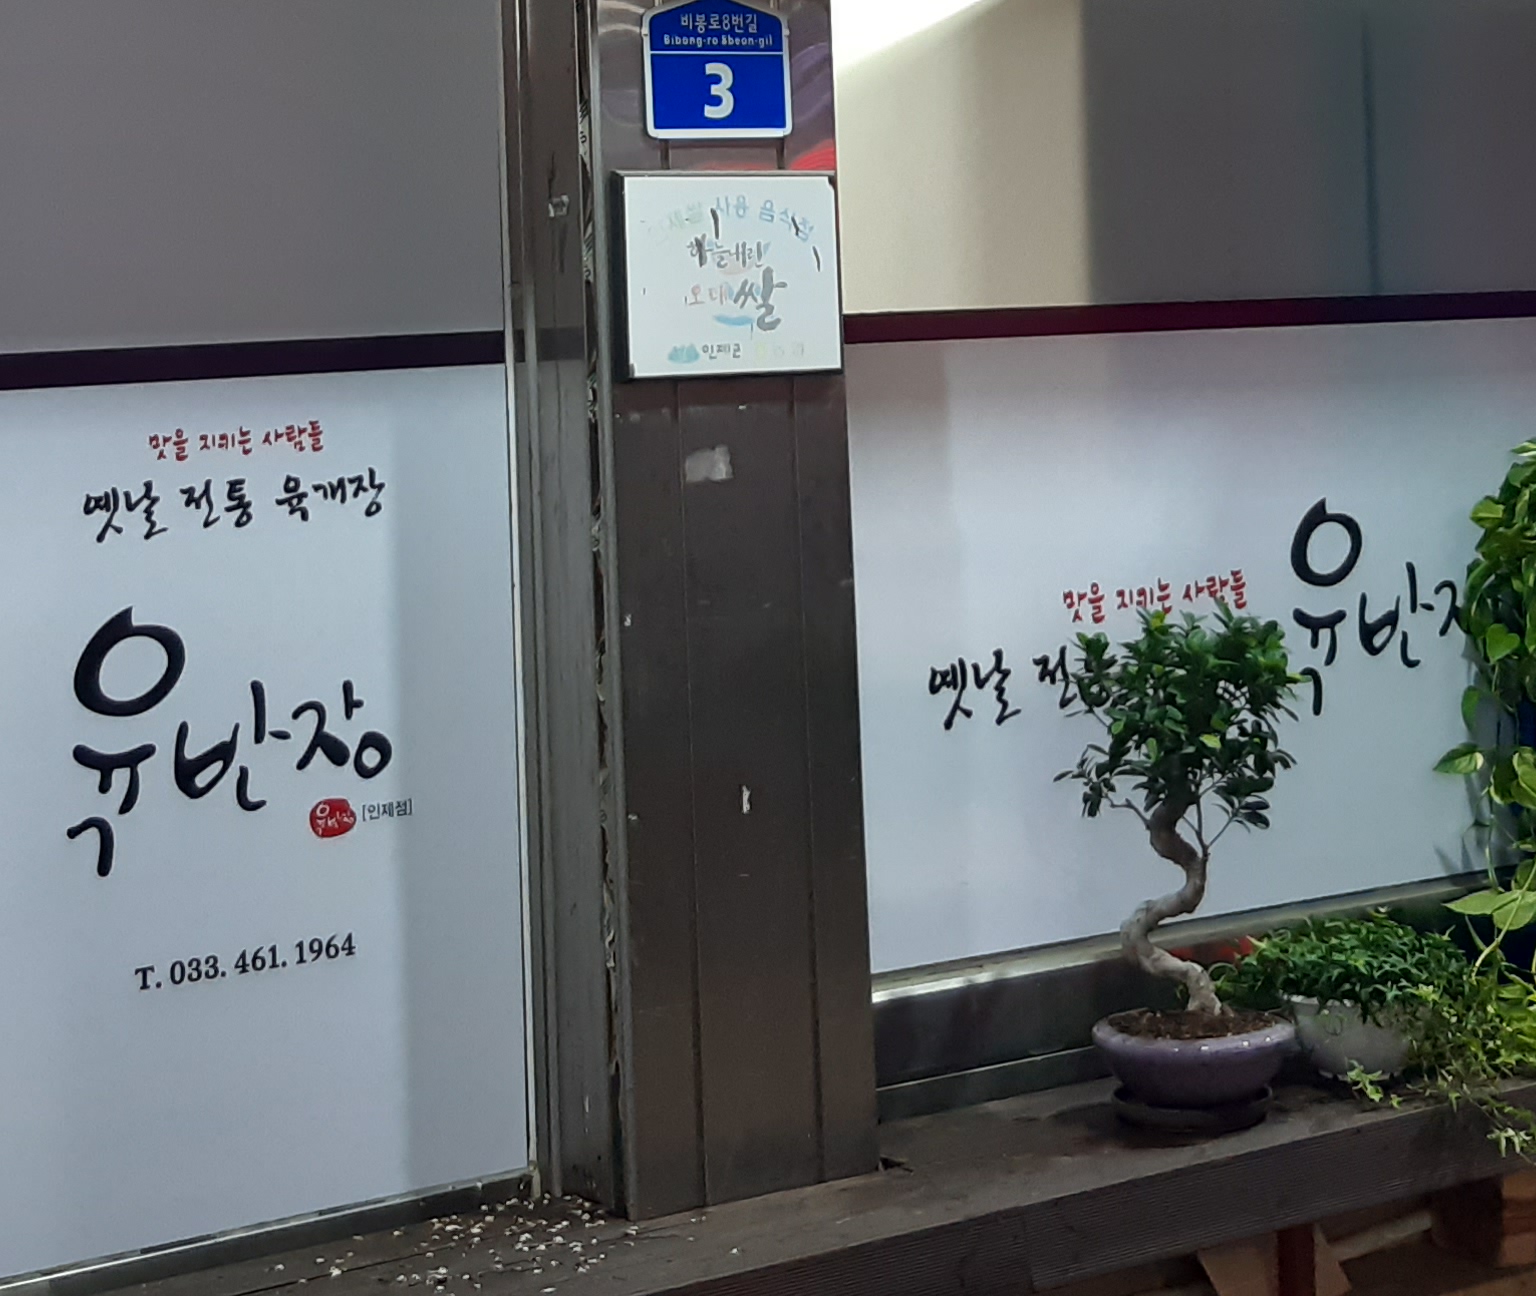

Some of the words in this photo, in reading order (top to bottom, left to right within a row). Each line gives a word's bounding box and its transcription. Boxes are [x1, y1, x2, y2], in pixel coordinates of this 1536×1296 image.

[664, 34, 718, 48] Bibong-ro
[721, 34, 773, 49] 8beon-gil
[680, 14, 758, 34] 비봉로8번길
[704, 62, 735, 119] 3
[149, 430, 188, 463] 맛을
[200, 429, 251, 456] 지키는
[263, 421, 322, 453] 사람들
[82, 479, 168, 544] 옛날
[179, 478, 253, 529] 전통
[275, 467, 386, 522] 육개장
[1064, 584, 1106, 624] 맛을
[1116, 578, 1173, 615] 지키는
[1184, 570, 1247, 610] 사람들
[928, 648, 1022, 731] 옛날
[1032, 645, 1077, 710] 전
[66, 606, 394, 878] 육반장
[362, 799, 413, 822] [인제점]
[134, 965, 162, 991] T.
[169, 955, 227, 986] 033.
[233, 944, 287, 975] 461.
[295, 932, 356, 965] 1964
